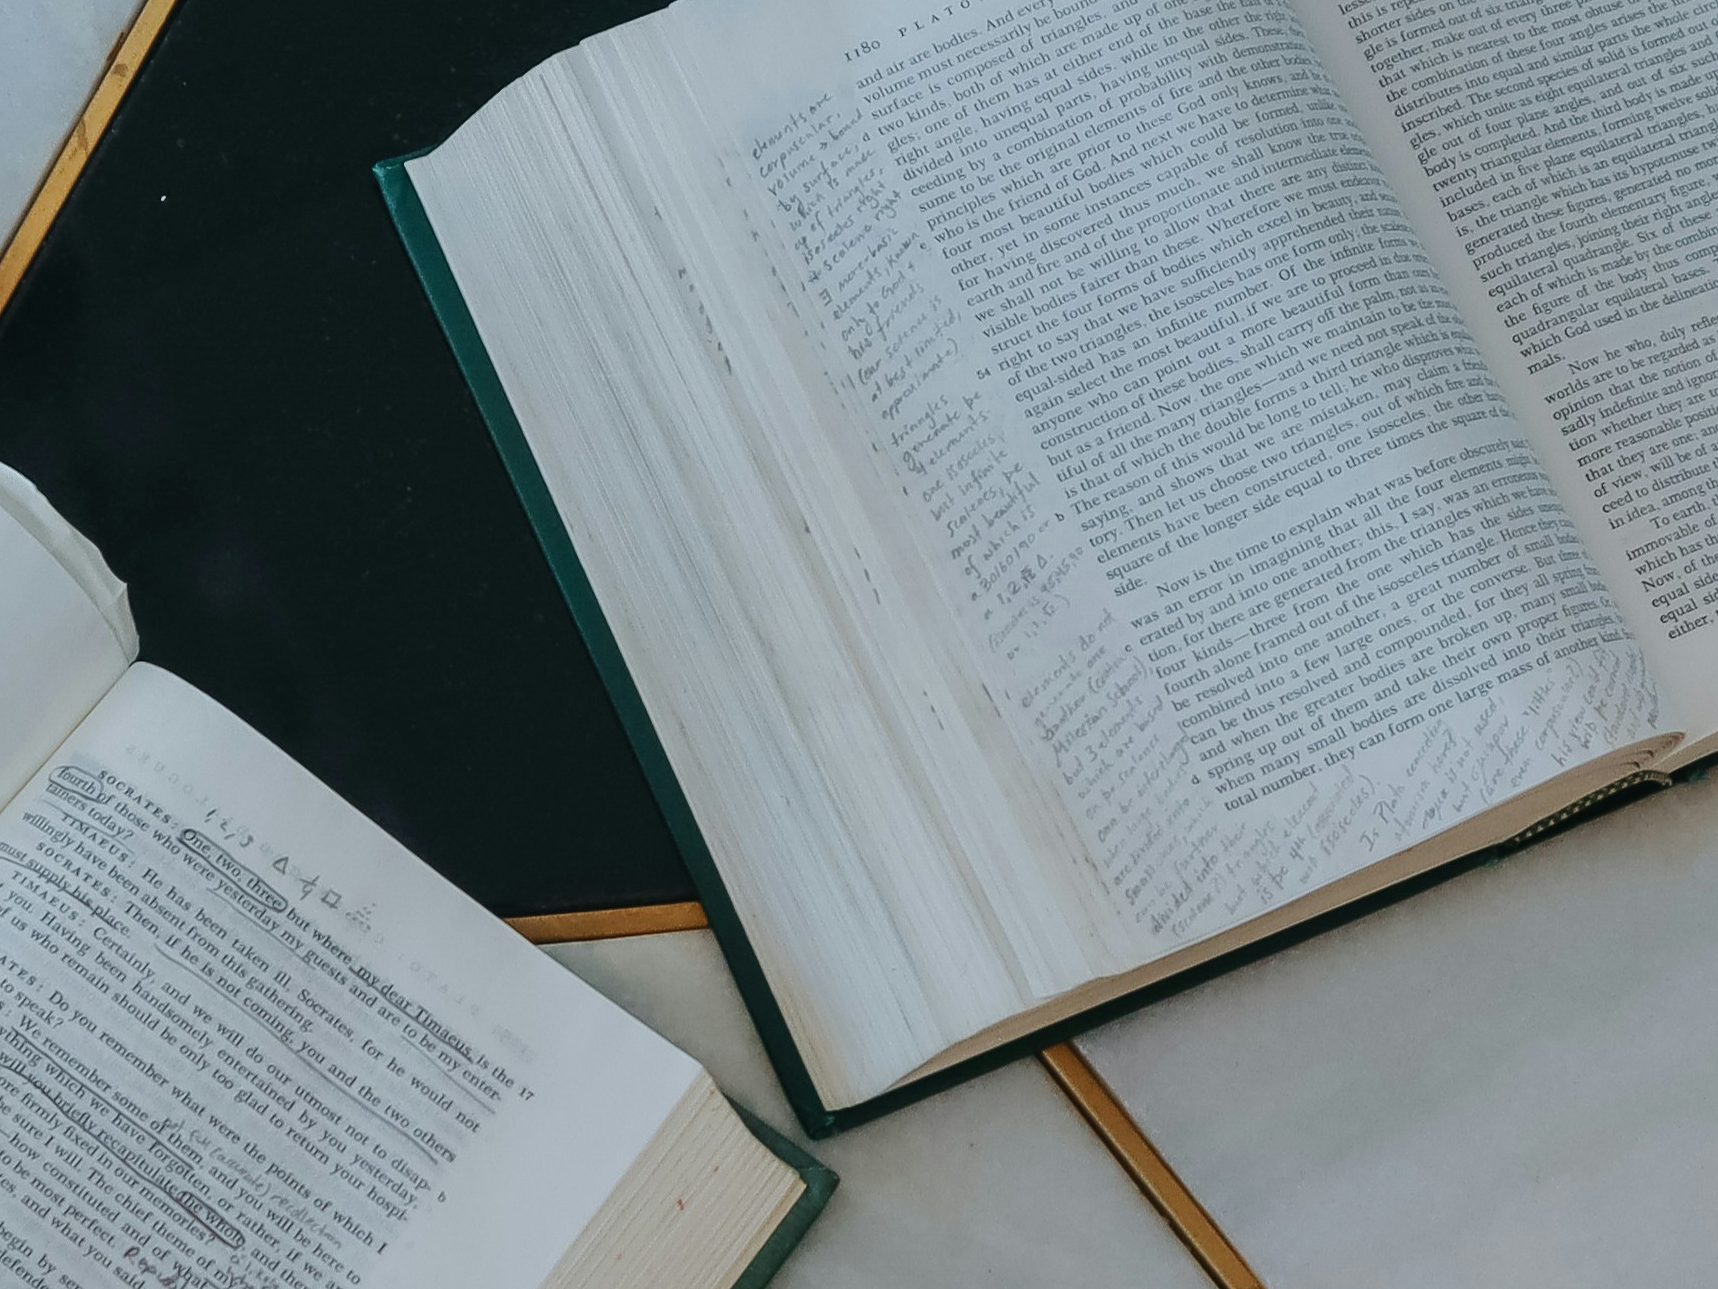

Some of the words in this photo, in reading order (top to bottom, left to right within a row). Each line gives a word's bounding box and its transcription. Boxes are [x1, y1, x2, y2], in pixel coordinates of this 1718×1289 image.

[844, 38, 882, 61] 1180
[1527, 353, 1566, 375] mals.
[1607, 517, 1626, 530] in
[1625, 503, 1661, 523] idea,
[1660, 484, 1707, 507] among
[1155, 576, 1190, 598] Now
[1192, 569, 1207, 582] is
[1209, 557, 1234, 574] the
[1235, 540, 1269, 562] time
[1271, 532, 1287, 545] to
[1289, 506, 1343, 536] explain
[1344, 486, 1382, 510] what
[1383, 473, 1413, 491] was
[1412, 455, 1458, 478] before
[1113, 578, 1147, 597] side.
[1668, 615, 1714, 640] either,
[1224, 787, 1259, 811] total
[1260, 764, 1322, 796] number,
[1321, 745, 1355, 771] they
[1359, 732, 1387, 750] can
[1388, 713, 1425, 737] form
[1428, 699, 1454, 717] one
[1454, 680, 1494, 703] large
[1496, 662, 1534, 684] mass
[1536, 650, 1551, 667] of
[1553, 632, 1600, 660] another
[22, 812, 76, 849] willingly
[73, 841, 107, 870] have
[107, 865, 140, 896] been
[140, 893, 186, 931] absent
[185, 926, 220, 958] from
[220, 954, 249, 978] this
[245, 976, 314, 1033] gathering.
[519, 1087, 535, 1101] 17
